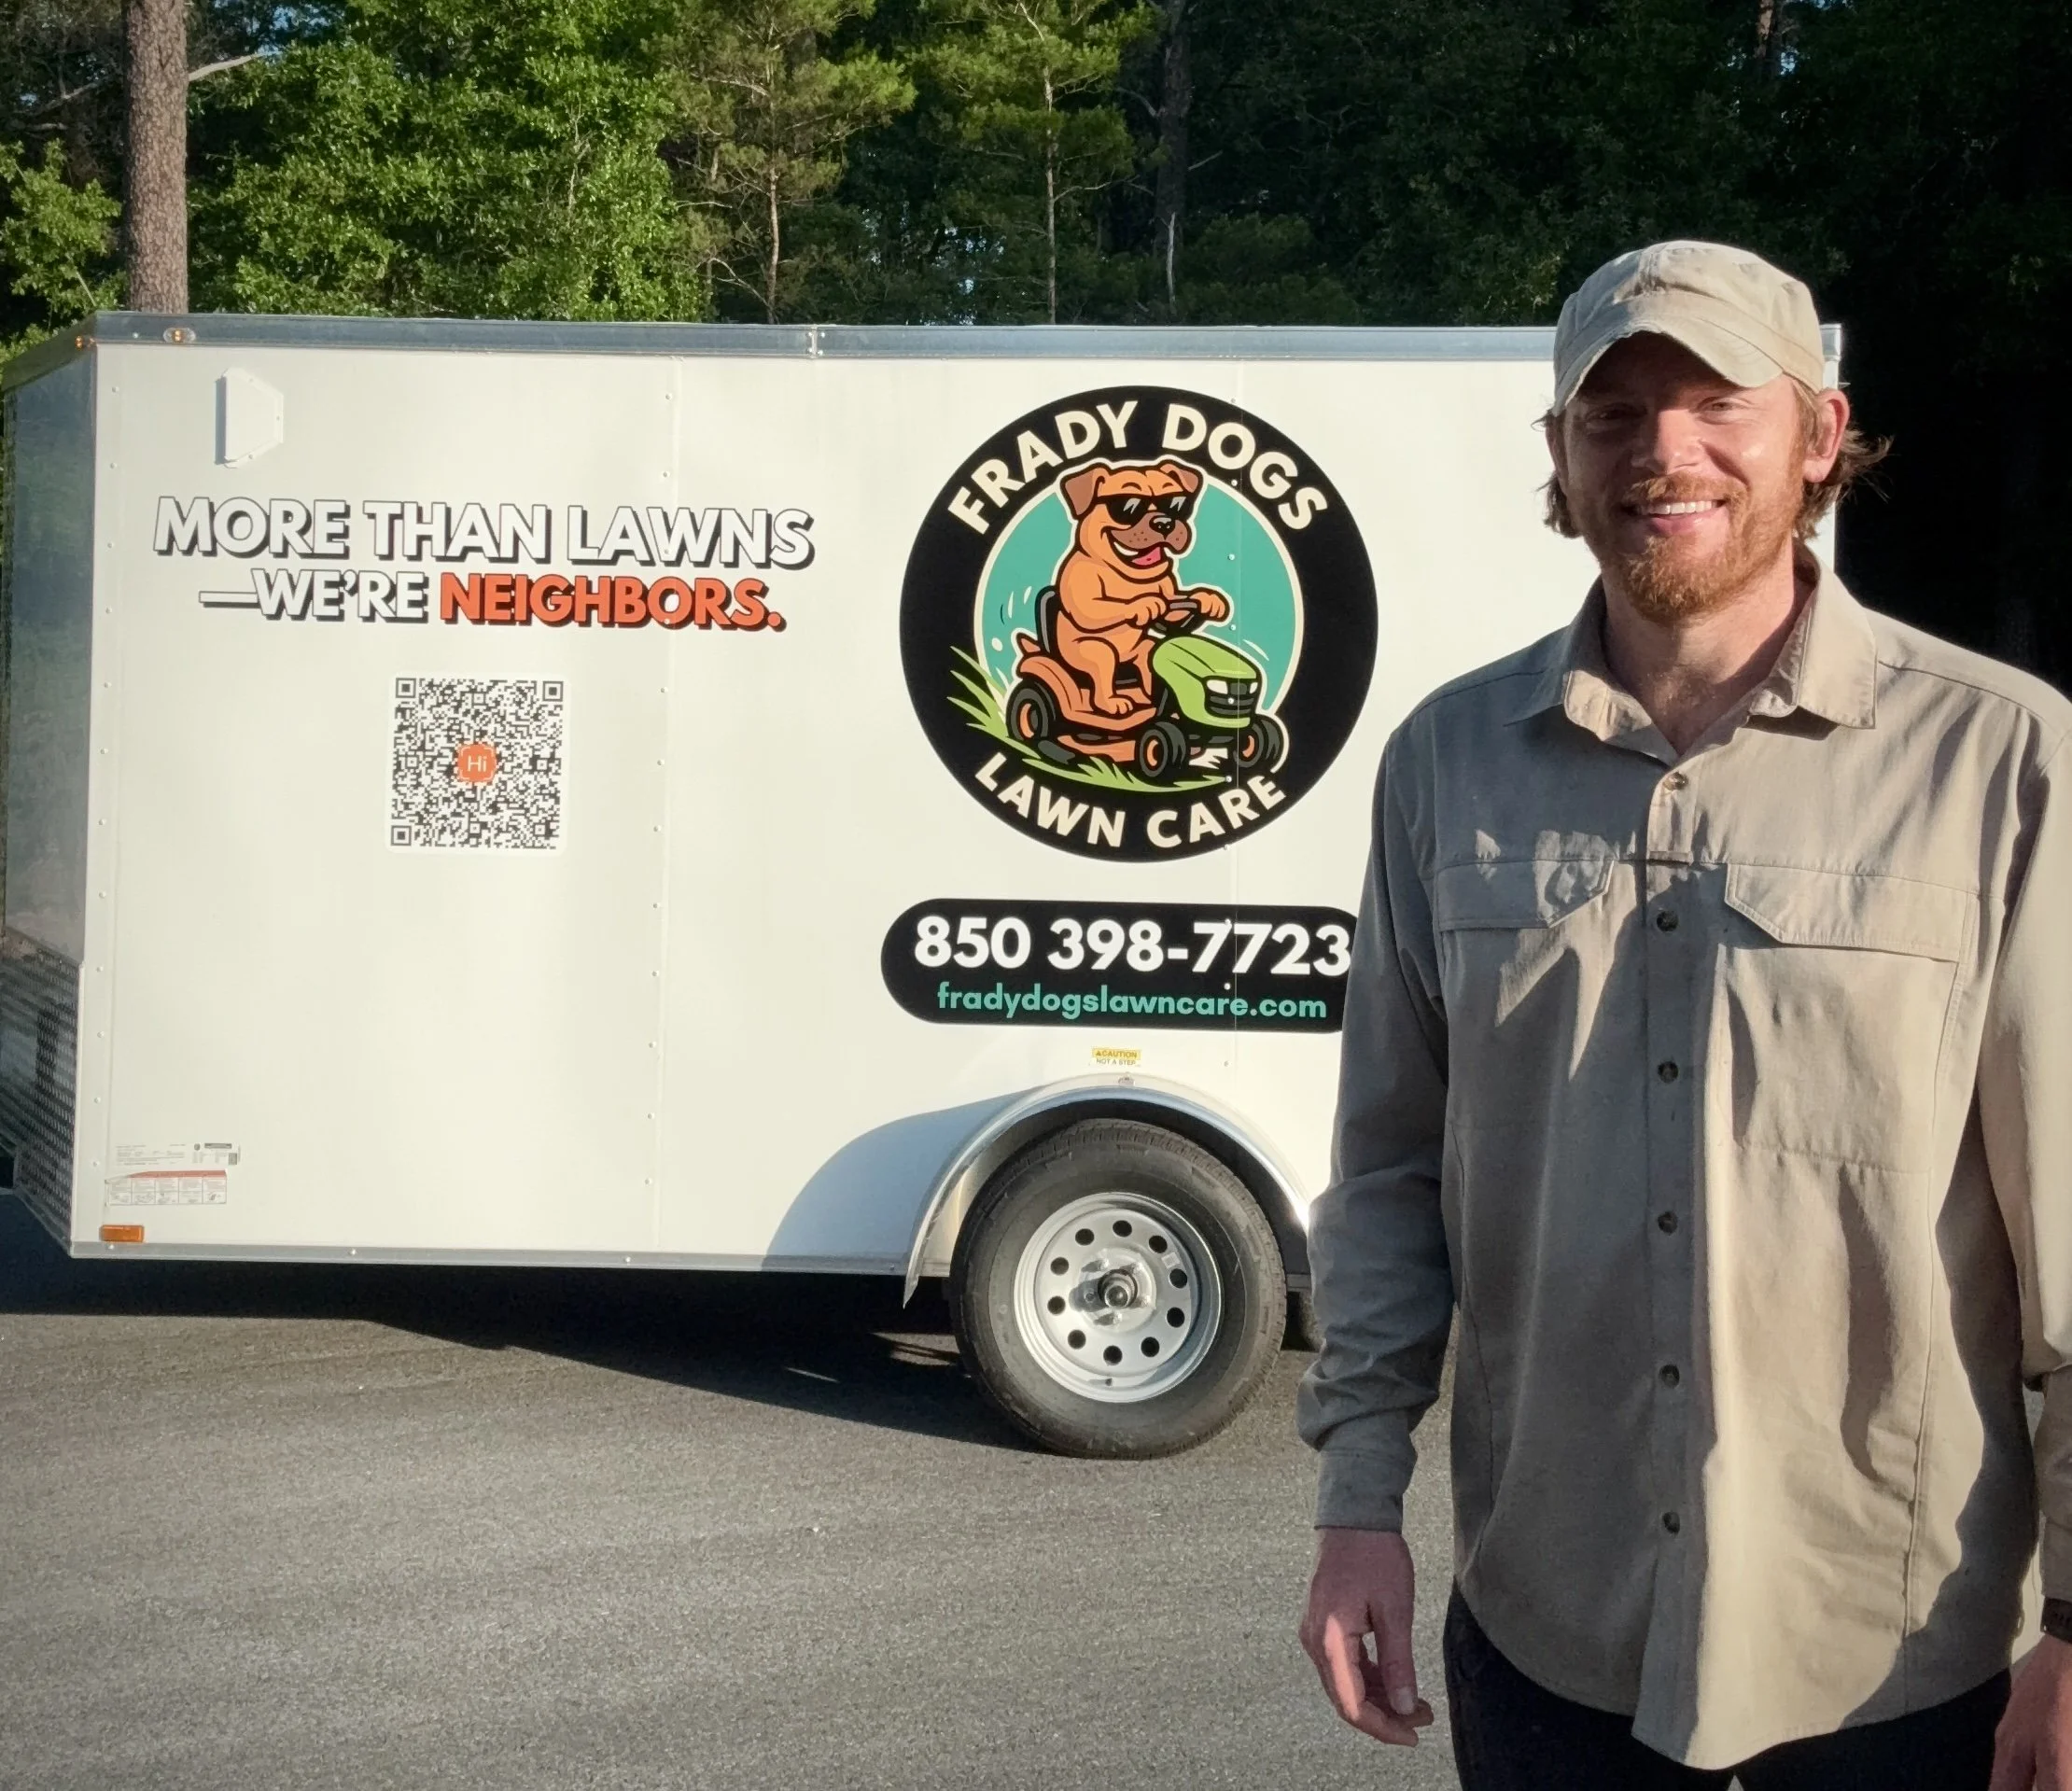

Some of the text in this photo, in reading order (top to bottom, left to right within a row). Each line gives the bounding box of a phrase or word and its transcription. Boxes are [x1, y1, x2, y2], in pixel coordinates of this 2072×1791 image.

[947, 401, 1328, 535] FRADY DOGS
[154, 496, 816, 571] MORE THAN LAWNS
[440, 572, 787, 633] NEIGHBORS.
[468, 754, 487, 772] Hi
[975, 752, 1286, 848] LAWN CARE
[914, 916, 1351, 976] 850 398-7723
[938, 981, 1326, 1020] fradydogslawncare.com
[1101, 1050, 1138, 1058] CAUTION
